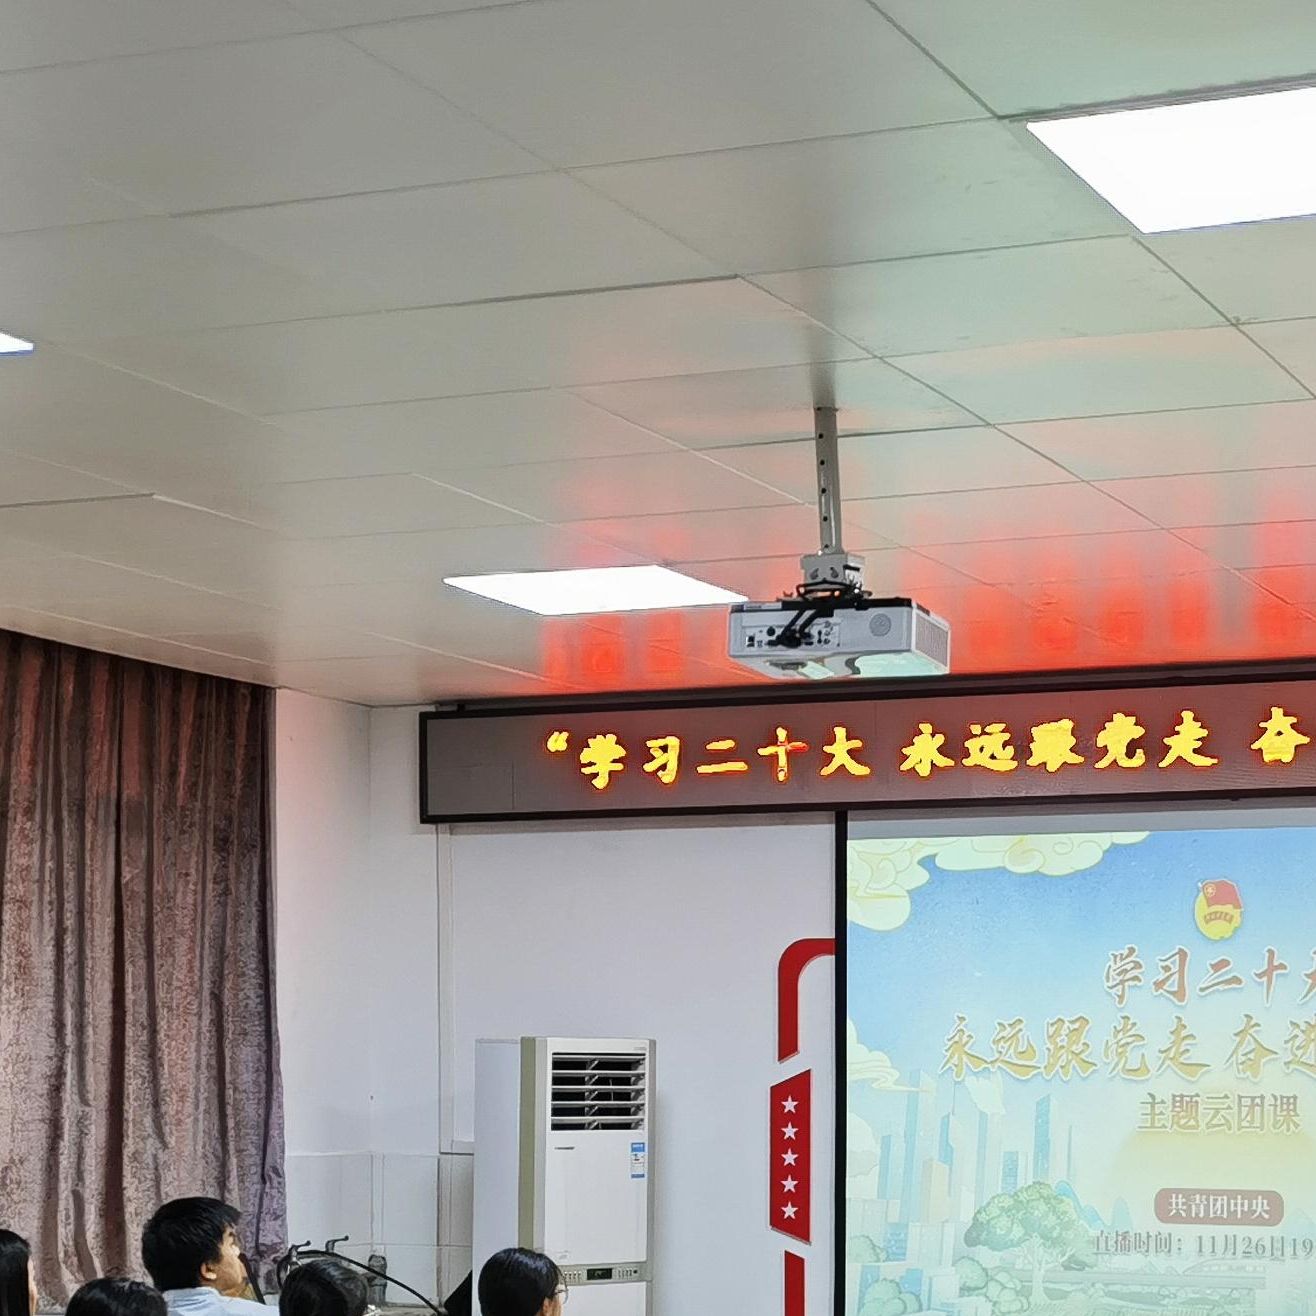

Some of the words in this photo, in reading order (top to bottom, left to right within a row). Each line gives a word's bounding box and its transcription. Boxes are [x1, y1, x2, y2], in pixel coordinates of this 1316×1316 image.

[898, 709, 1219, 778] 永远跟党走
[940, 1014, 1211, 1080] 永远跟党走
[1137, 1093, 1301, 1133] 主题云团课
[1168, 1193, 1270, 1220] 共青团中央
